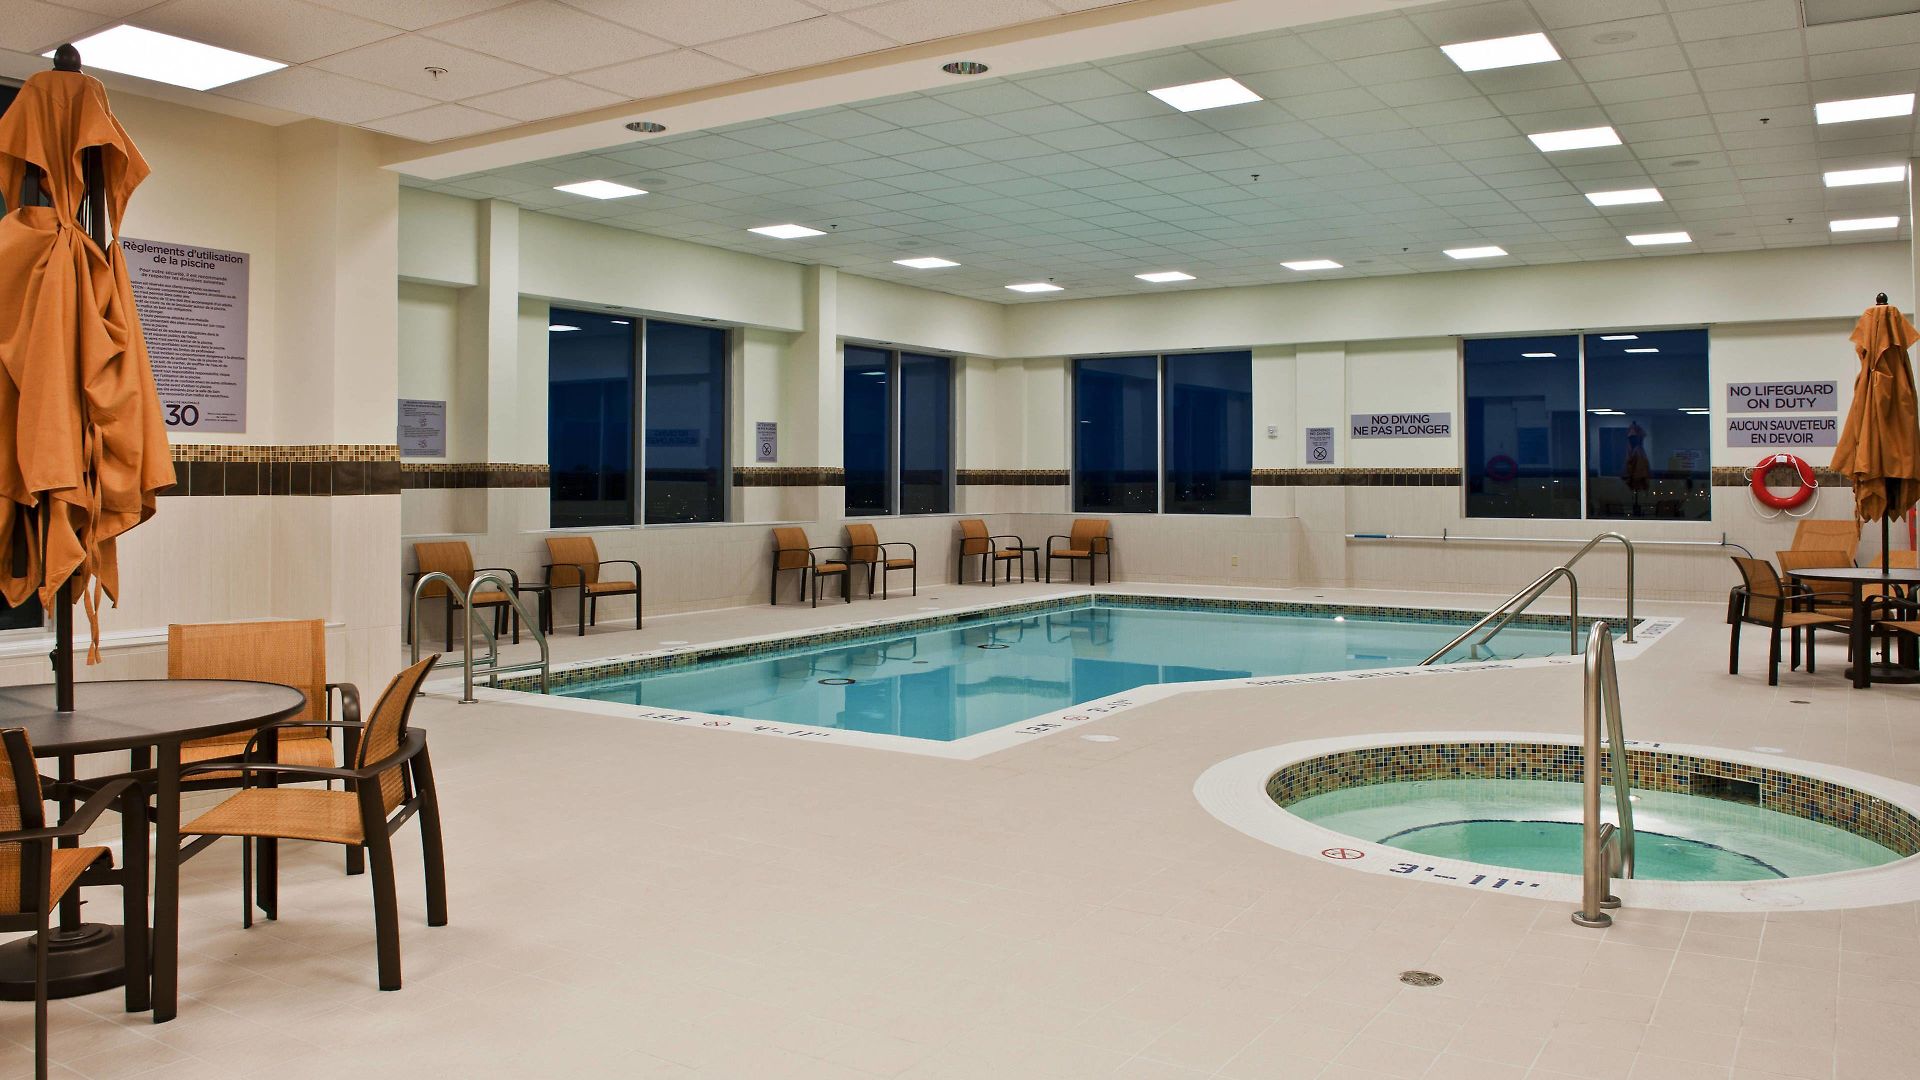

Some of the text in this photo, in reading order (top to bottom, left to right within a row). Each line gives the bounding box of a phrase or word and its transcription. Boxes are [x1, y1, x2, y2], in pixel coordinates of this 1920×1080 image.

[123, 240, 243, 264] Règlements d'utilisation
[153, 254, 216, 270] de la piscine
[1730, 384, 1834, 396] NO LIFEGUARD
[1747, 398, 1817, 409] ON DUTY
[165, 404, 199, 426] 30
[1371, 414, 1430, 424] NO DIVING
[1353, 424, 1449, 436] NE PAS PLONGER
[1729, 420, 1836, 431] AUCUN SAUVETEUR
[1751, 433, 1814, 444] EN DEVOIR
